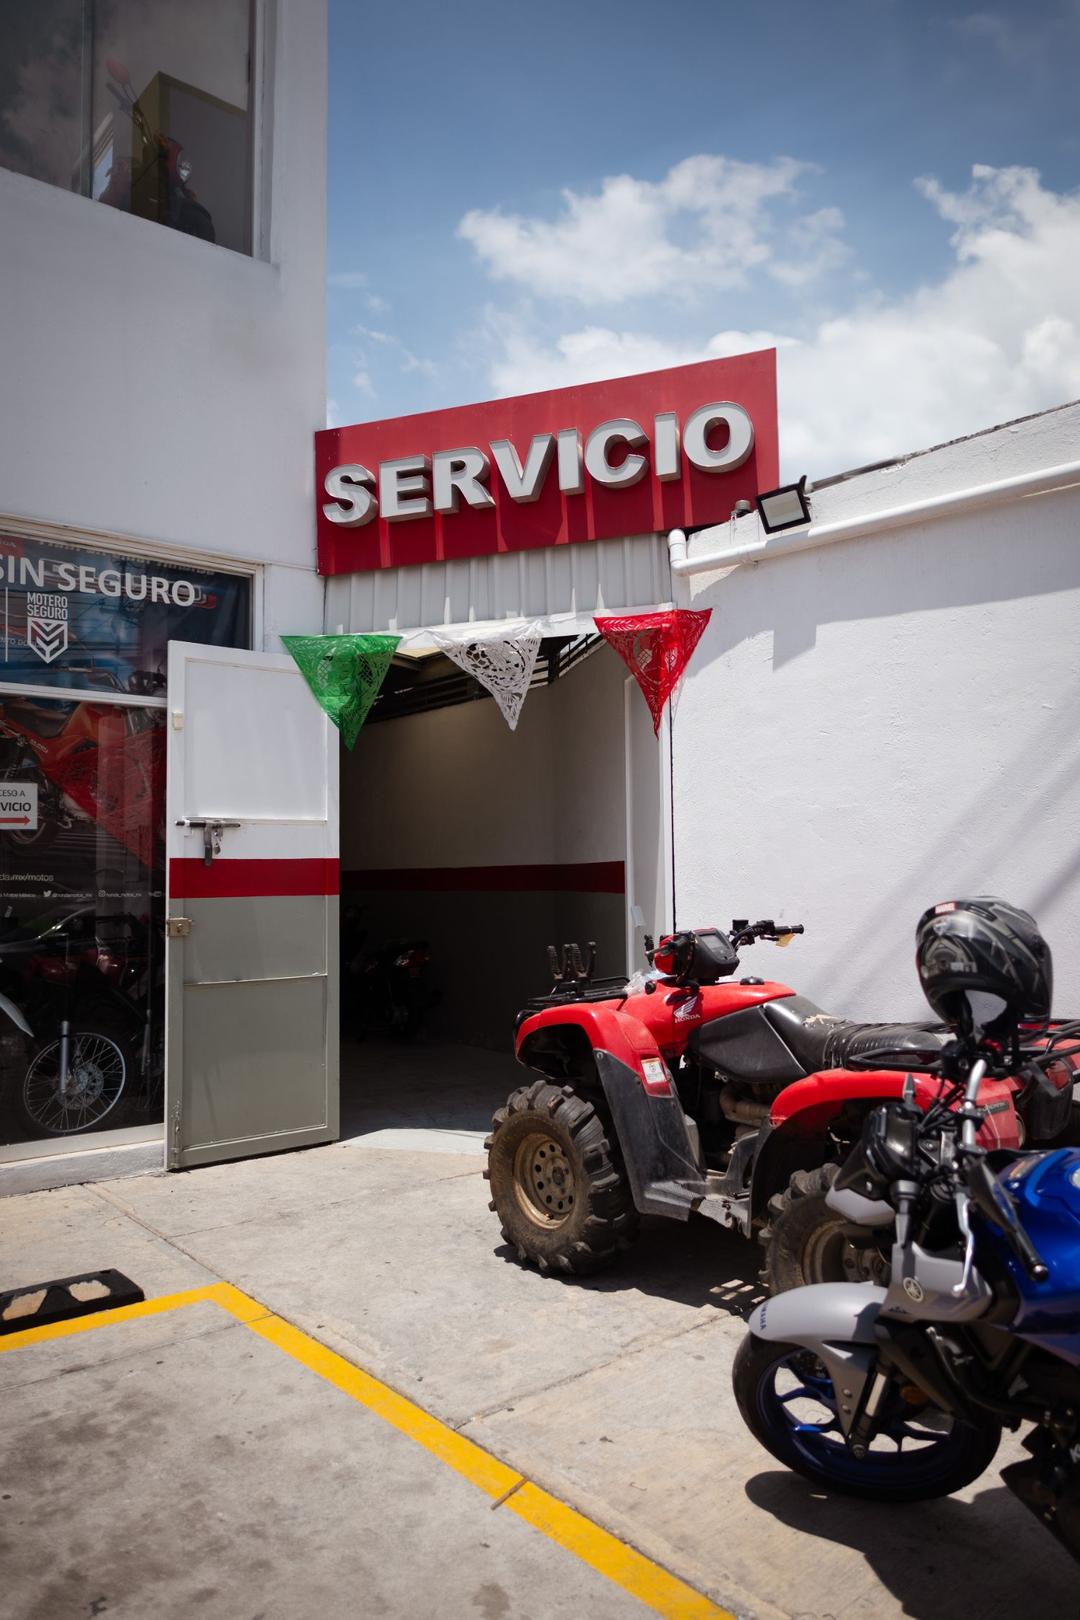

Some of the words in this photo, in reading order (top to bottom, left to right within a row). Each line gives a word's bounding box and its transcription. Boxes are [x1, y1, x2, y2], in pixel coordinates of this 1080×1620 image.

[322, 400, 755, 528] SERVICIO
[0, 554, 44, 587] IN
[58, 562, 195, 607] SEGURO
[27, 592, 68, 608] MOTERO
[27, 604, 68, 620] SEGURO
[19, 789, 26, 798] A
[674, 1014, 701, 1023] HONDA
